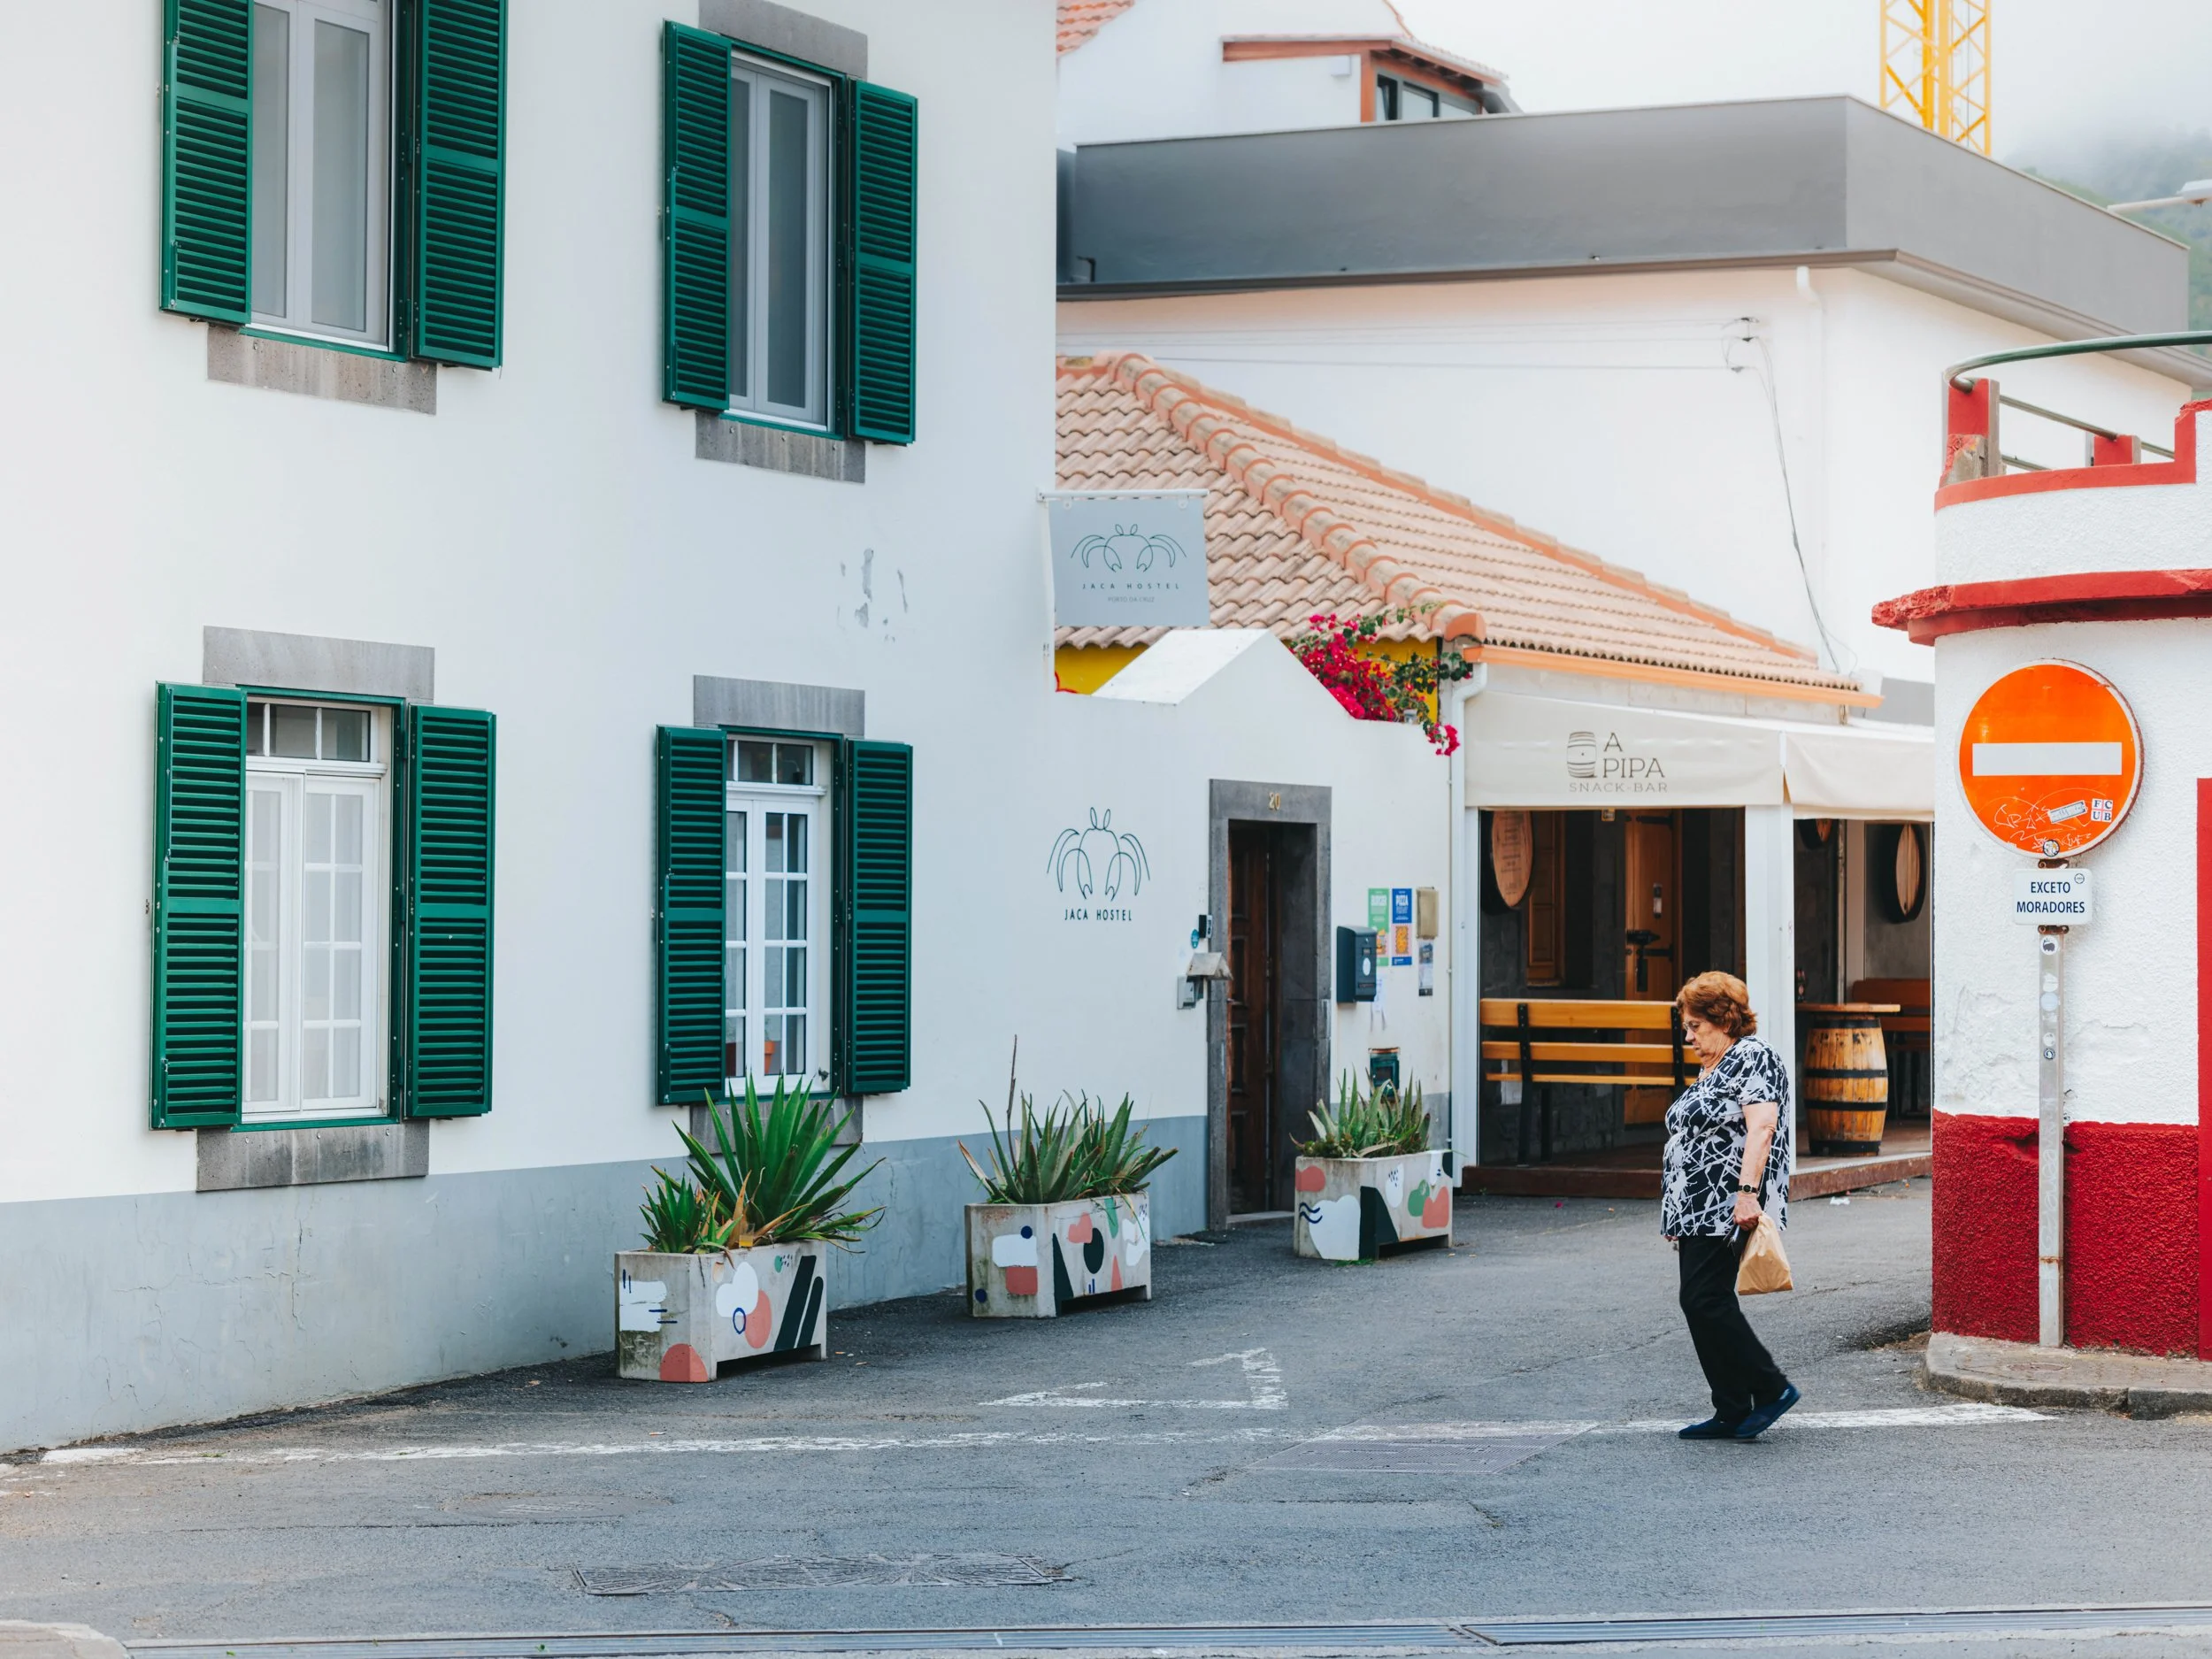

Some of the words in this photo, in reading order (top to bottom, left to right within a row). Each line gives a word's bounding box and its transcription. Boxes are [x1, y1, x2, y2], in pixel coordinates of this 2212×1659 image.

[1603, 732, 1623, 752] A
[1602, 757, 1665, 778] PIPA
[2031, 881, 2071, 894] EXCETO
[2016, 901, 2085, 913] MORADORES
[1064, 909, 1088, 921] JACA
[1096, 909, 1132, 921] HOSTEL
